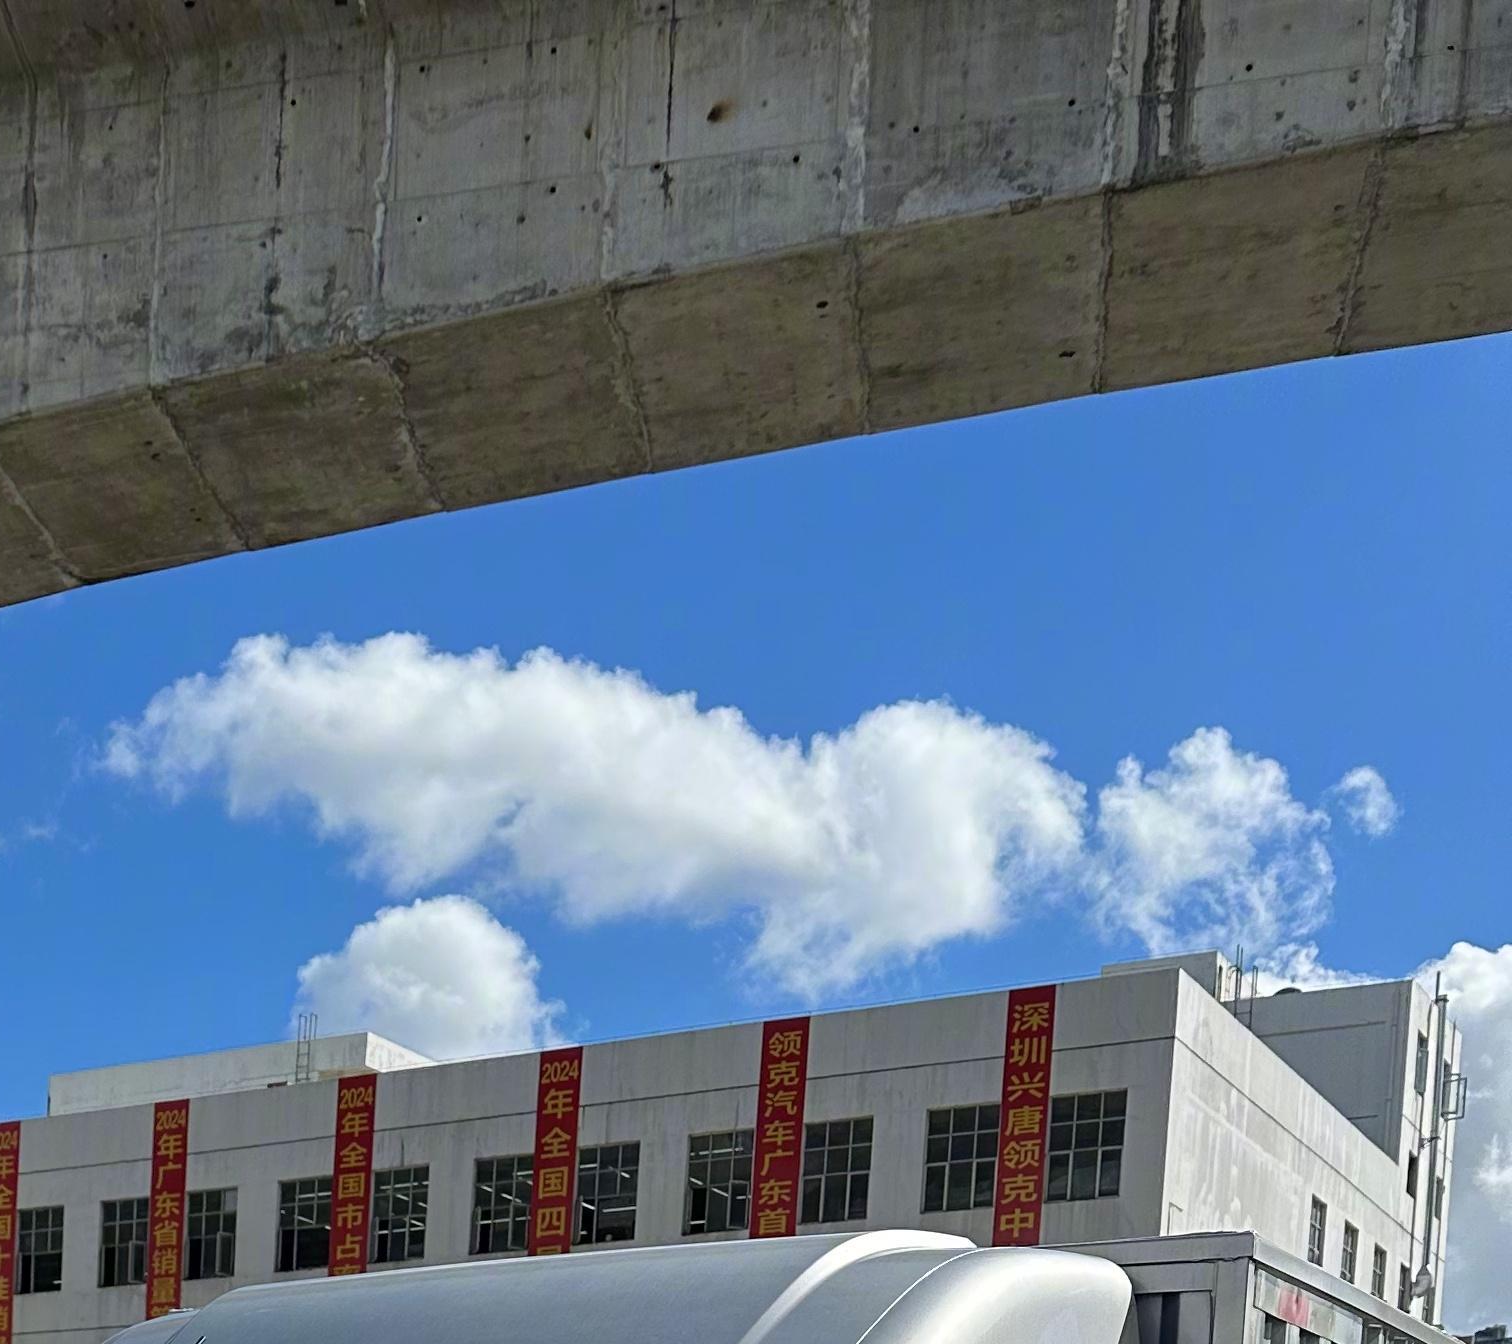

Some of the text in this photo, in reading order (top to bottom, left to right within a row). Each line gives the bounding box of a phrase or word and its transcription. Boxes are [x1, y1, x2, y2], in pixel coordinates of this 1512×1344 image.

[757, 1029, 804, 1236] 领克汽车广东首
[998, 1001, 1051, 1239] 深圳兴唐领克中
